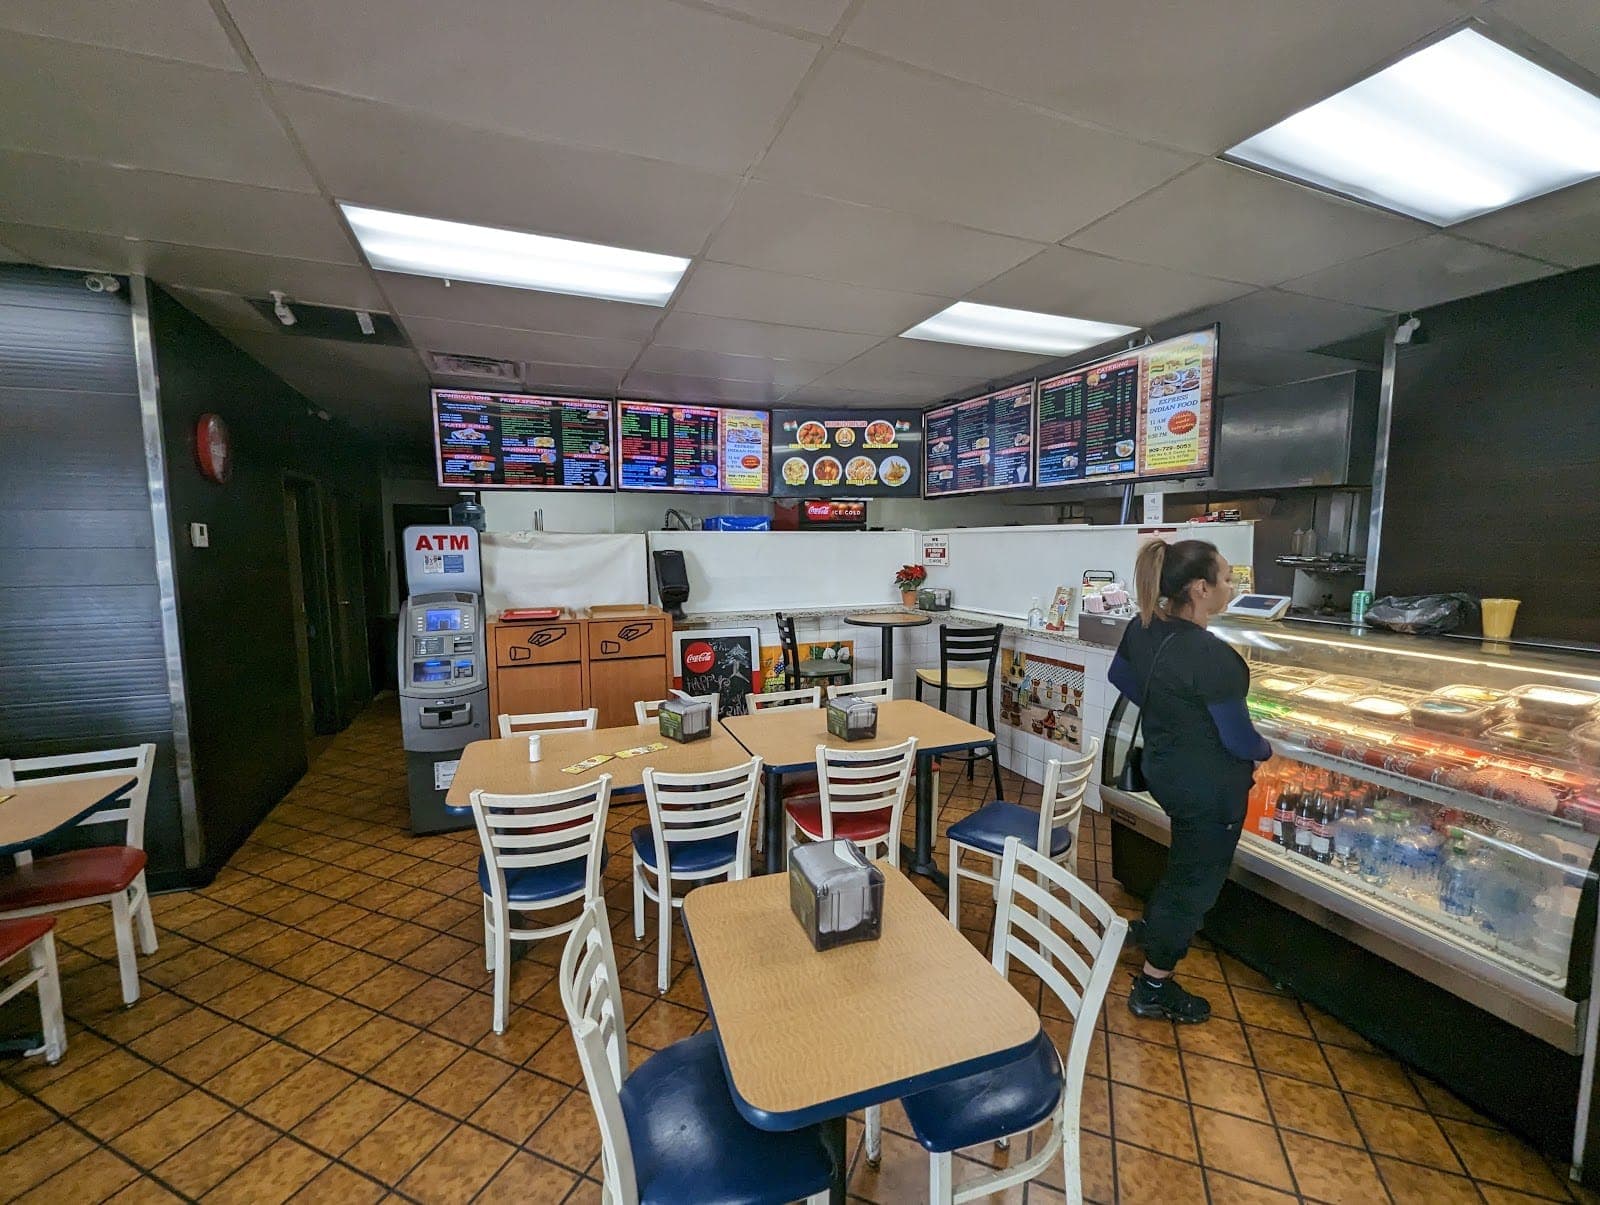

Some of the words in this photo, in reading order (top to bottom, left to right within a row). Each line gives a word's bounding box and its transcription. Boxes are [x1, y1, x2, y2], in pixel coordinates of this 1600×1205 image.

[1158, 394, 1189, 405] EXPRESS
[1149, 404, 1176, 414] INDIAN
[1177, 400, 1199, 409] FOOD
[808, 505, 830, 515] Coca-Cola
[415, 535, 469, 551] ATM
[686, 651, 712, 664] Coca-Cola
